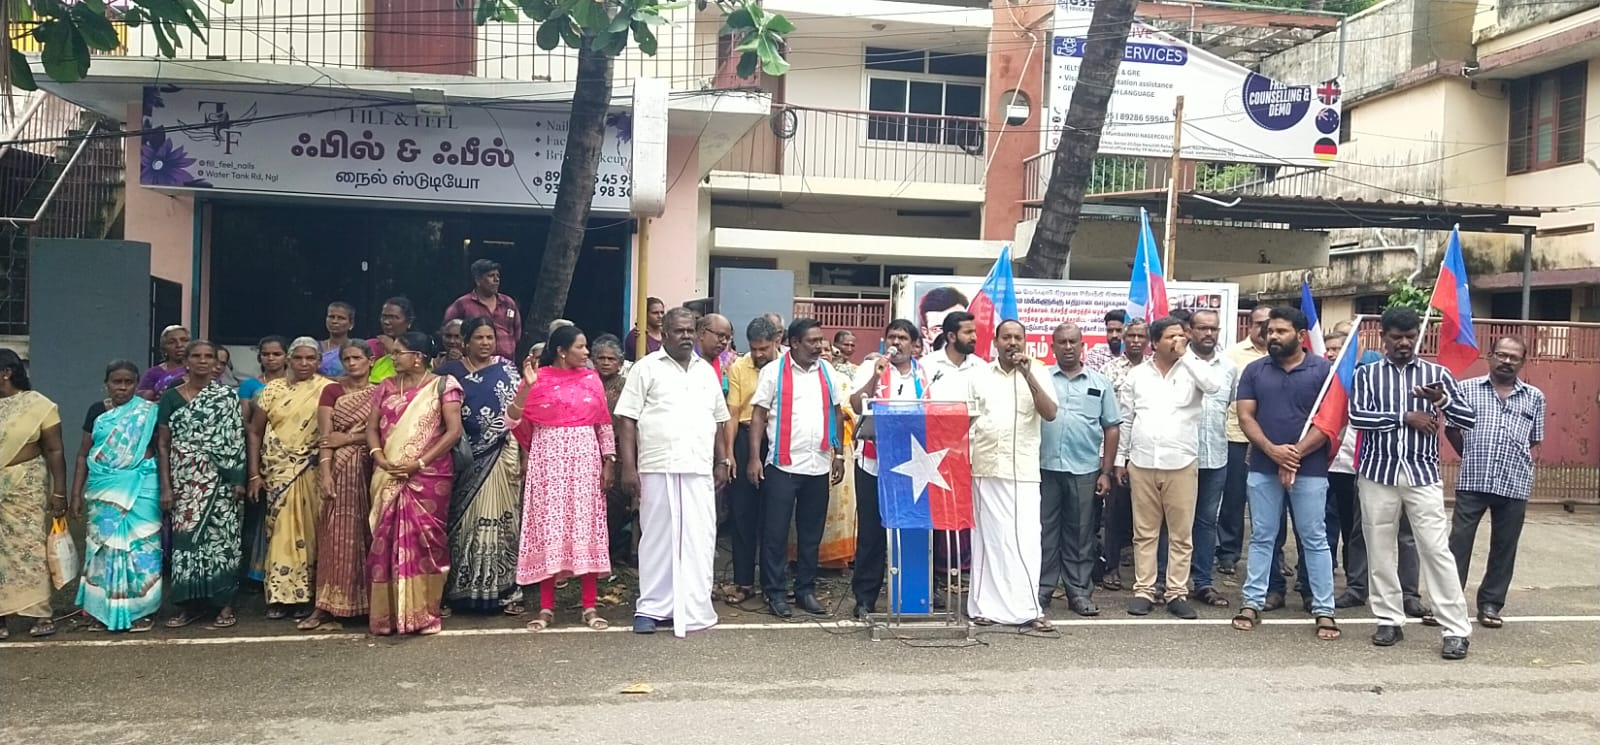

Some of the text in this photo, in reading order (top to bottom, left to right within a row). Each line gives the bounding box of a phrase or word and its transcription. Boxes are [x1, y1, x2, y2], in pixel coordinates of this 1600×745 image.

[1125, 46, 1183, 63] ERVICES
[1139, 81, 1173, 89] assistance
[1120, 89, 1155, 98] LANGUAGE
[1249, 88, 1310, 105] COUNSELLING &
[1268, 102, 1292, 117] DEMO
[394, 112, 408, 126] &
[546, 120, 569, 131] Nail
[291, 129, 515, 168] ஃபில் & ஃபீல்
[206, 170, 230, 178] Water
[231, 171, 250, 179] Tank
[335, 168, 481, 192] நைல் ஸ்டுடியோ
